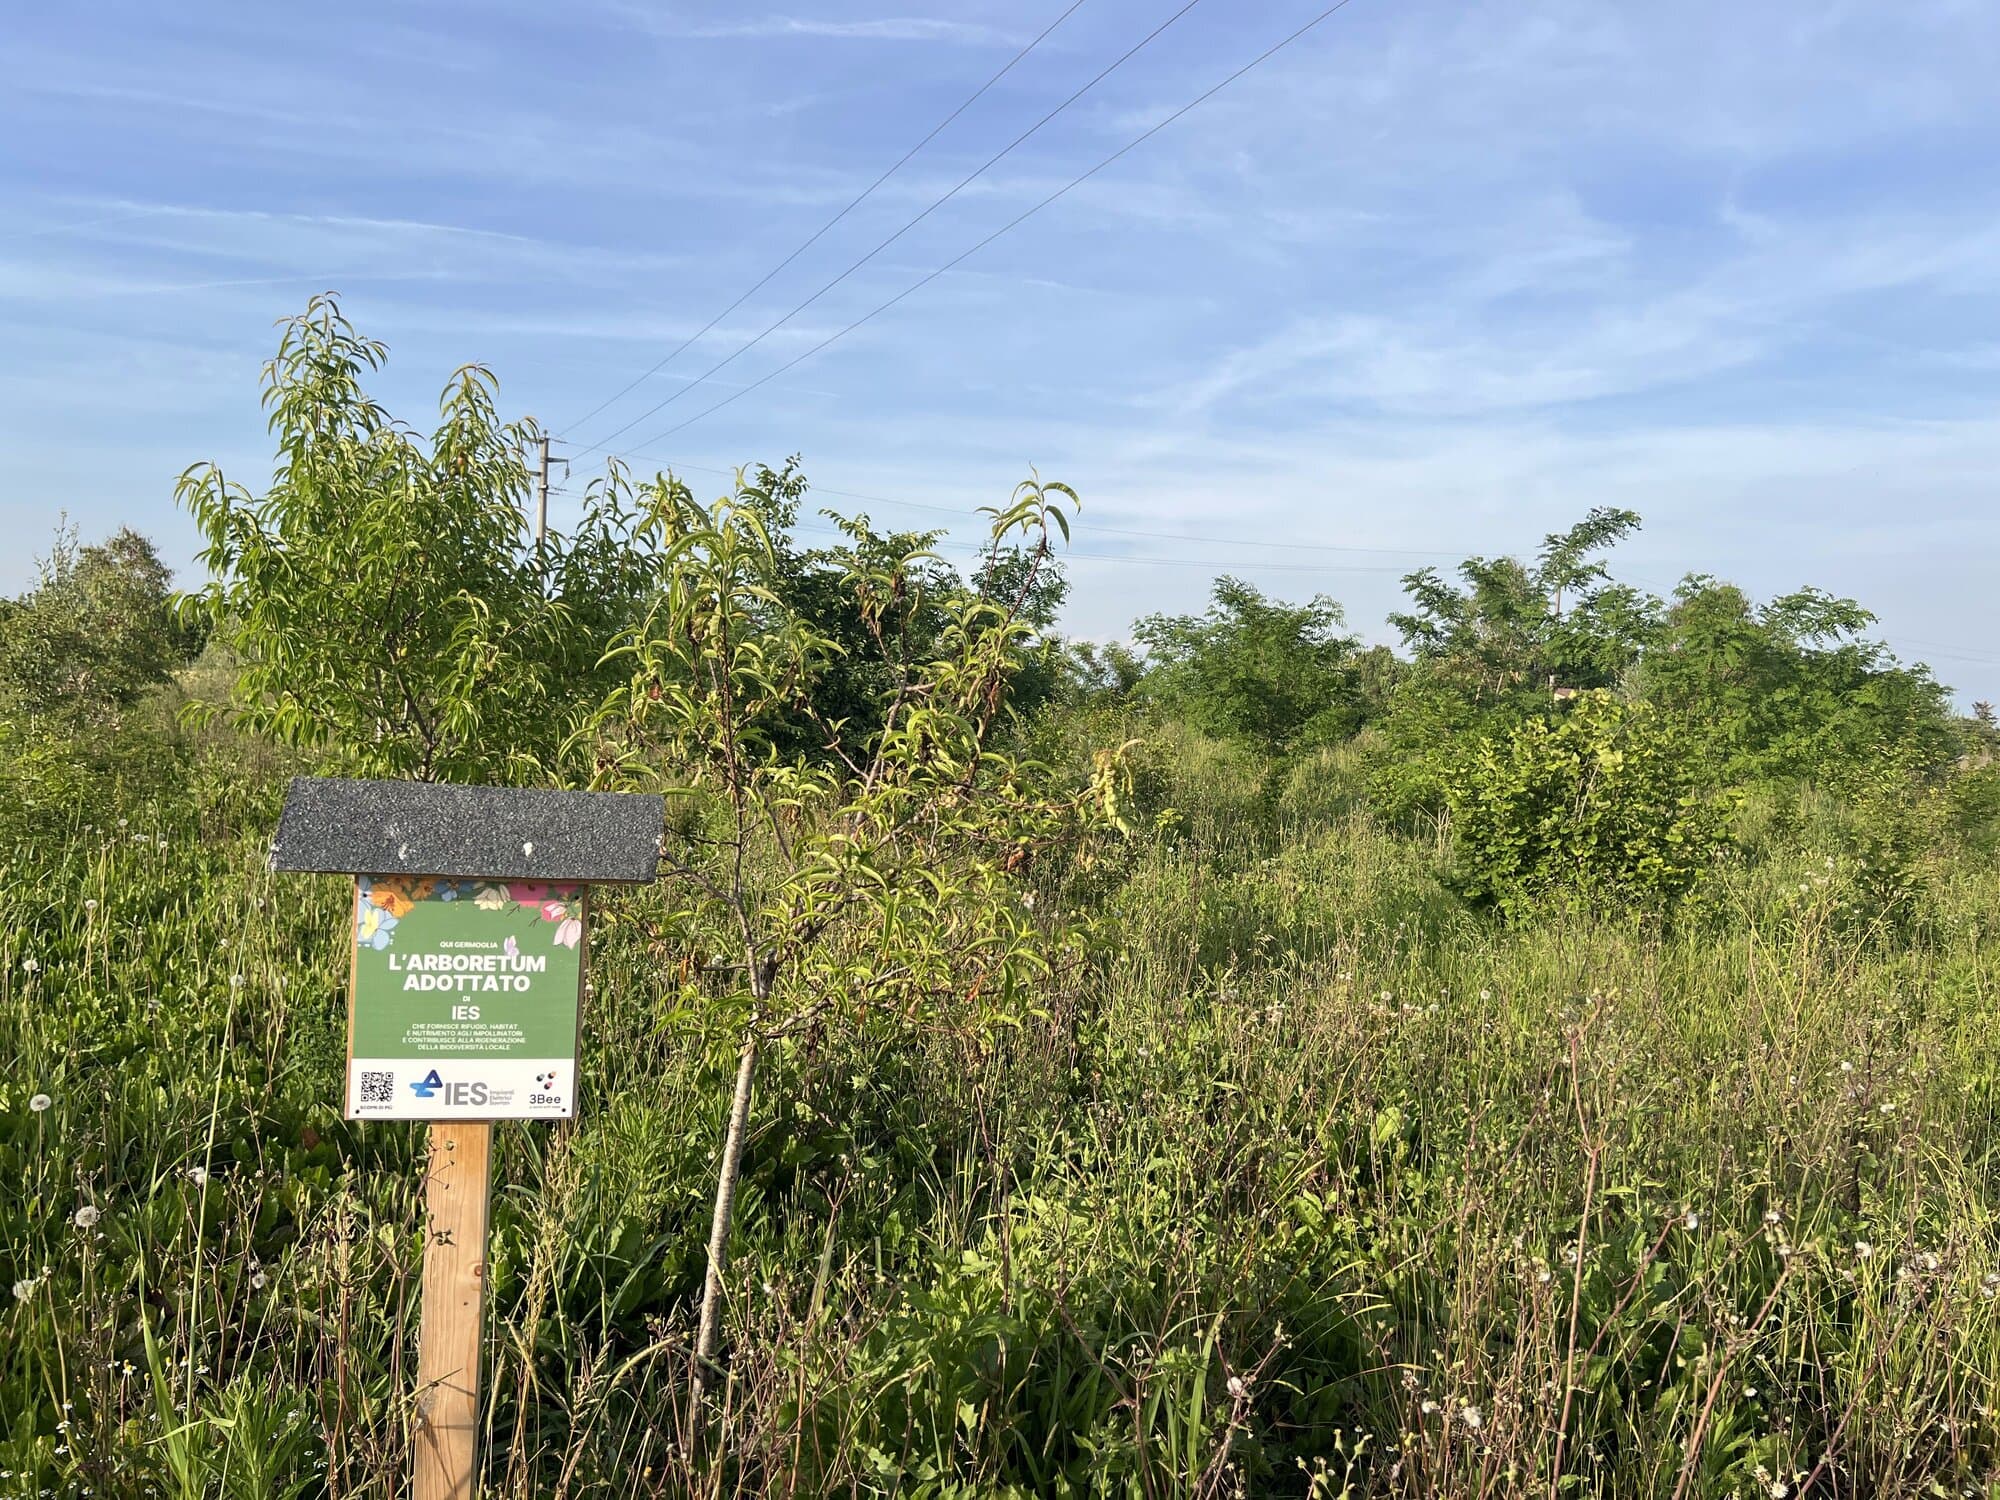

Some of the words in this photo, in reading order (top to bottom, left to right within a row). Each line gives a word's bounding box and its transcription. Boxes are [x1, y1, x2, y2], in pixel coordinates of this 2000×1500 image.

[454, 941, 498, 949] GERMOGLIA
[403, 974, 531, 991] ADOTTATO
[452, 1005, 480, 1020] IES
[444, 1082, 488, 1106] IES
[529, 1094, 561, 1105] 3Bee
